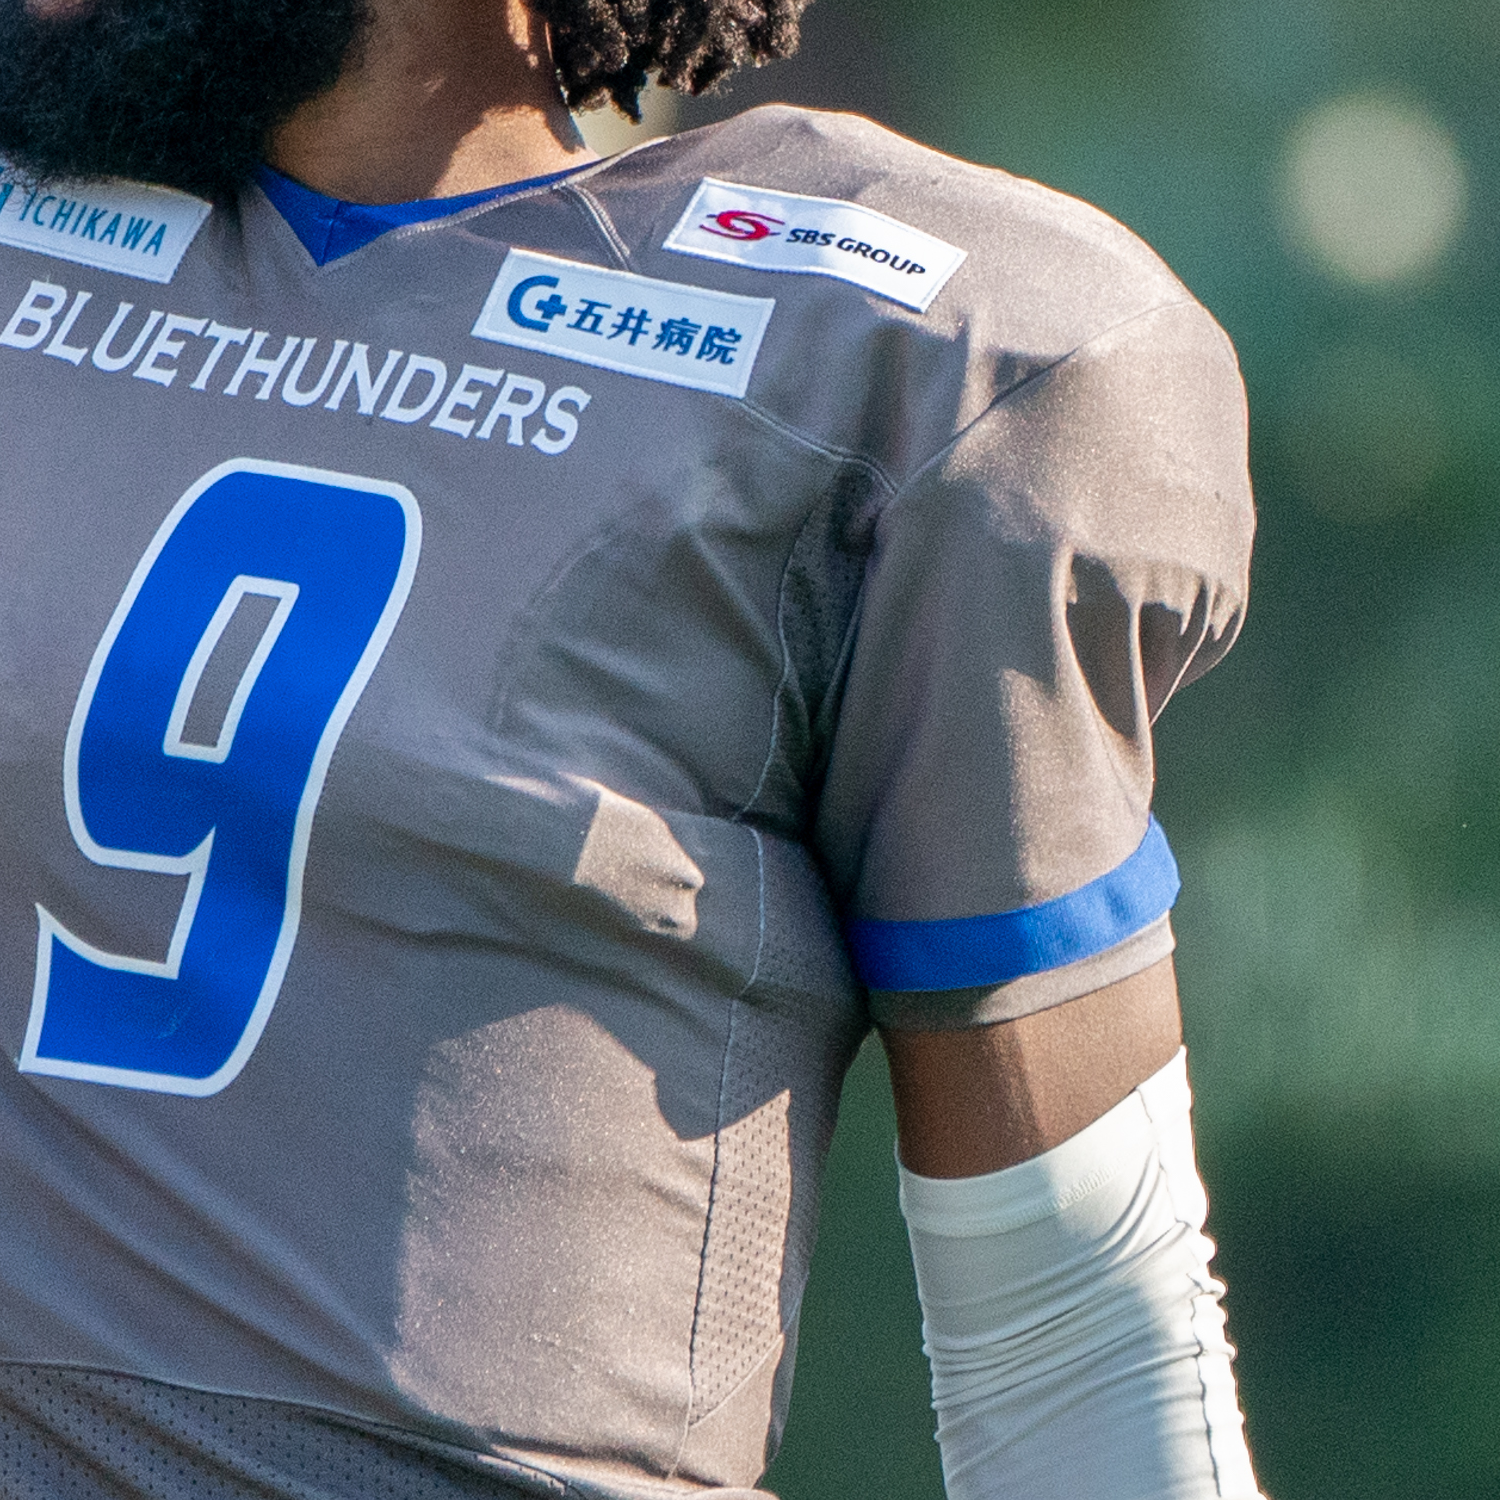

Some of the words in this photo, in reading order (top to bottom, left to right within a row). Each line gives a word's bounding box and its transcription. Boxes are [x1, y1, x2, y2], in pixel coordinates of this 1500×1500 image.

[18, 191, 168, 257] ICHIKAWA
[785, 227, 837, 247] SBS
[836, 237, 926, 275] GROUP
[566, 298, 743, 366] 五井病院
[17, 456, 423, 1098] 9
